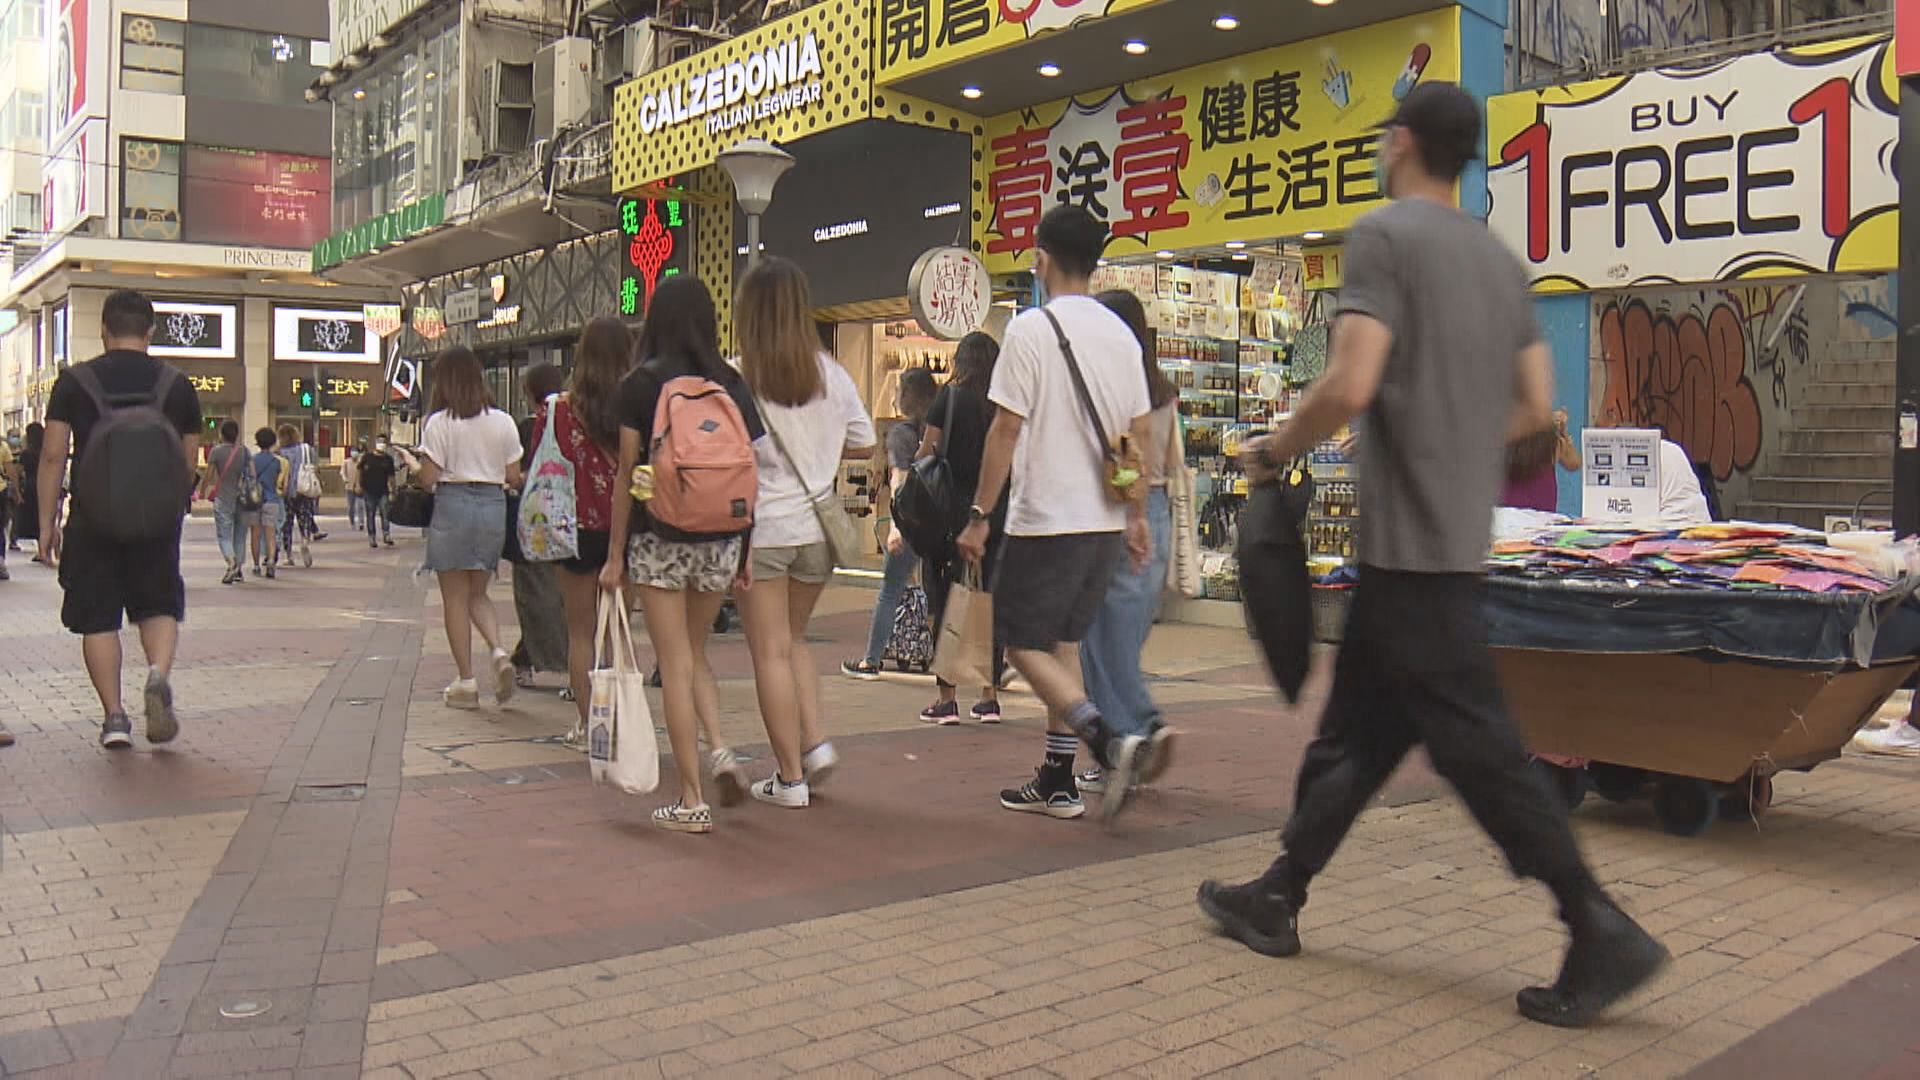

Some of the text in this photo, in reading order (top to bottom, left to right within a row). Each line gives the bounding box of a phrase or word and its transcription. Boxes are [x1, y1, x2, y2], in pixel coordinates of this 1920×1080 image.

[639, 32, 821, 135] CALZEDONIA
[706, 80, 821, 137] ITALIAN LEGWEAR
[1197, 70, 1302, 152] 健康
[1631, 89, 1739, 132] BUY
[1500, 77, 1851, 263] 1 FREE 1
[223, 248, 279, 267] PRINCE
[814, 219, 868, 242] CALZEDONIA
